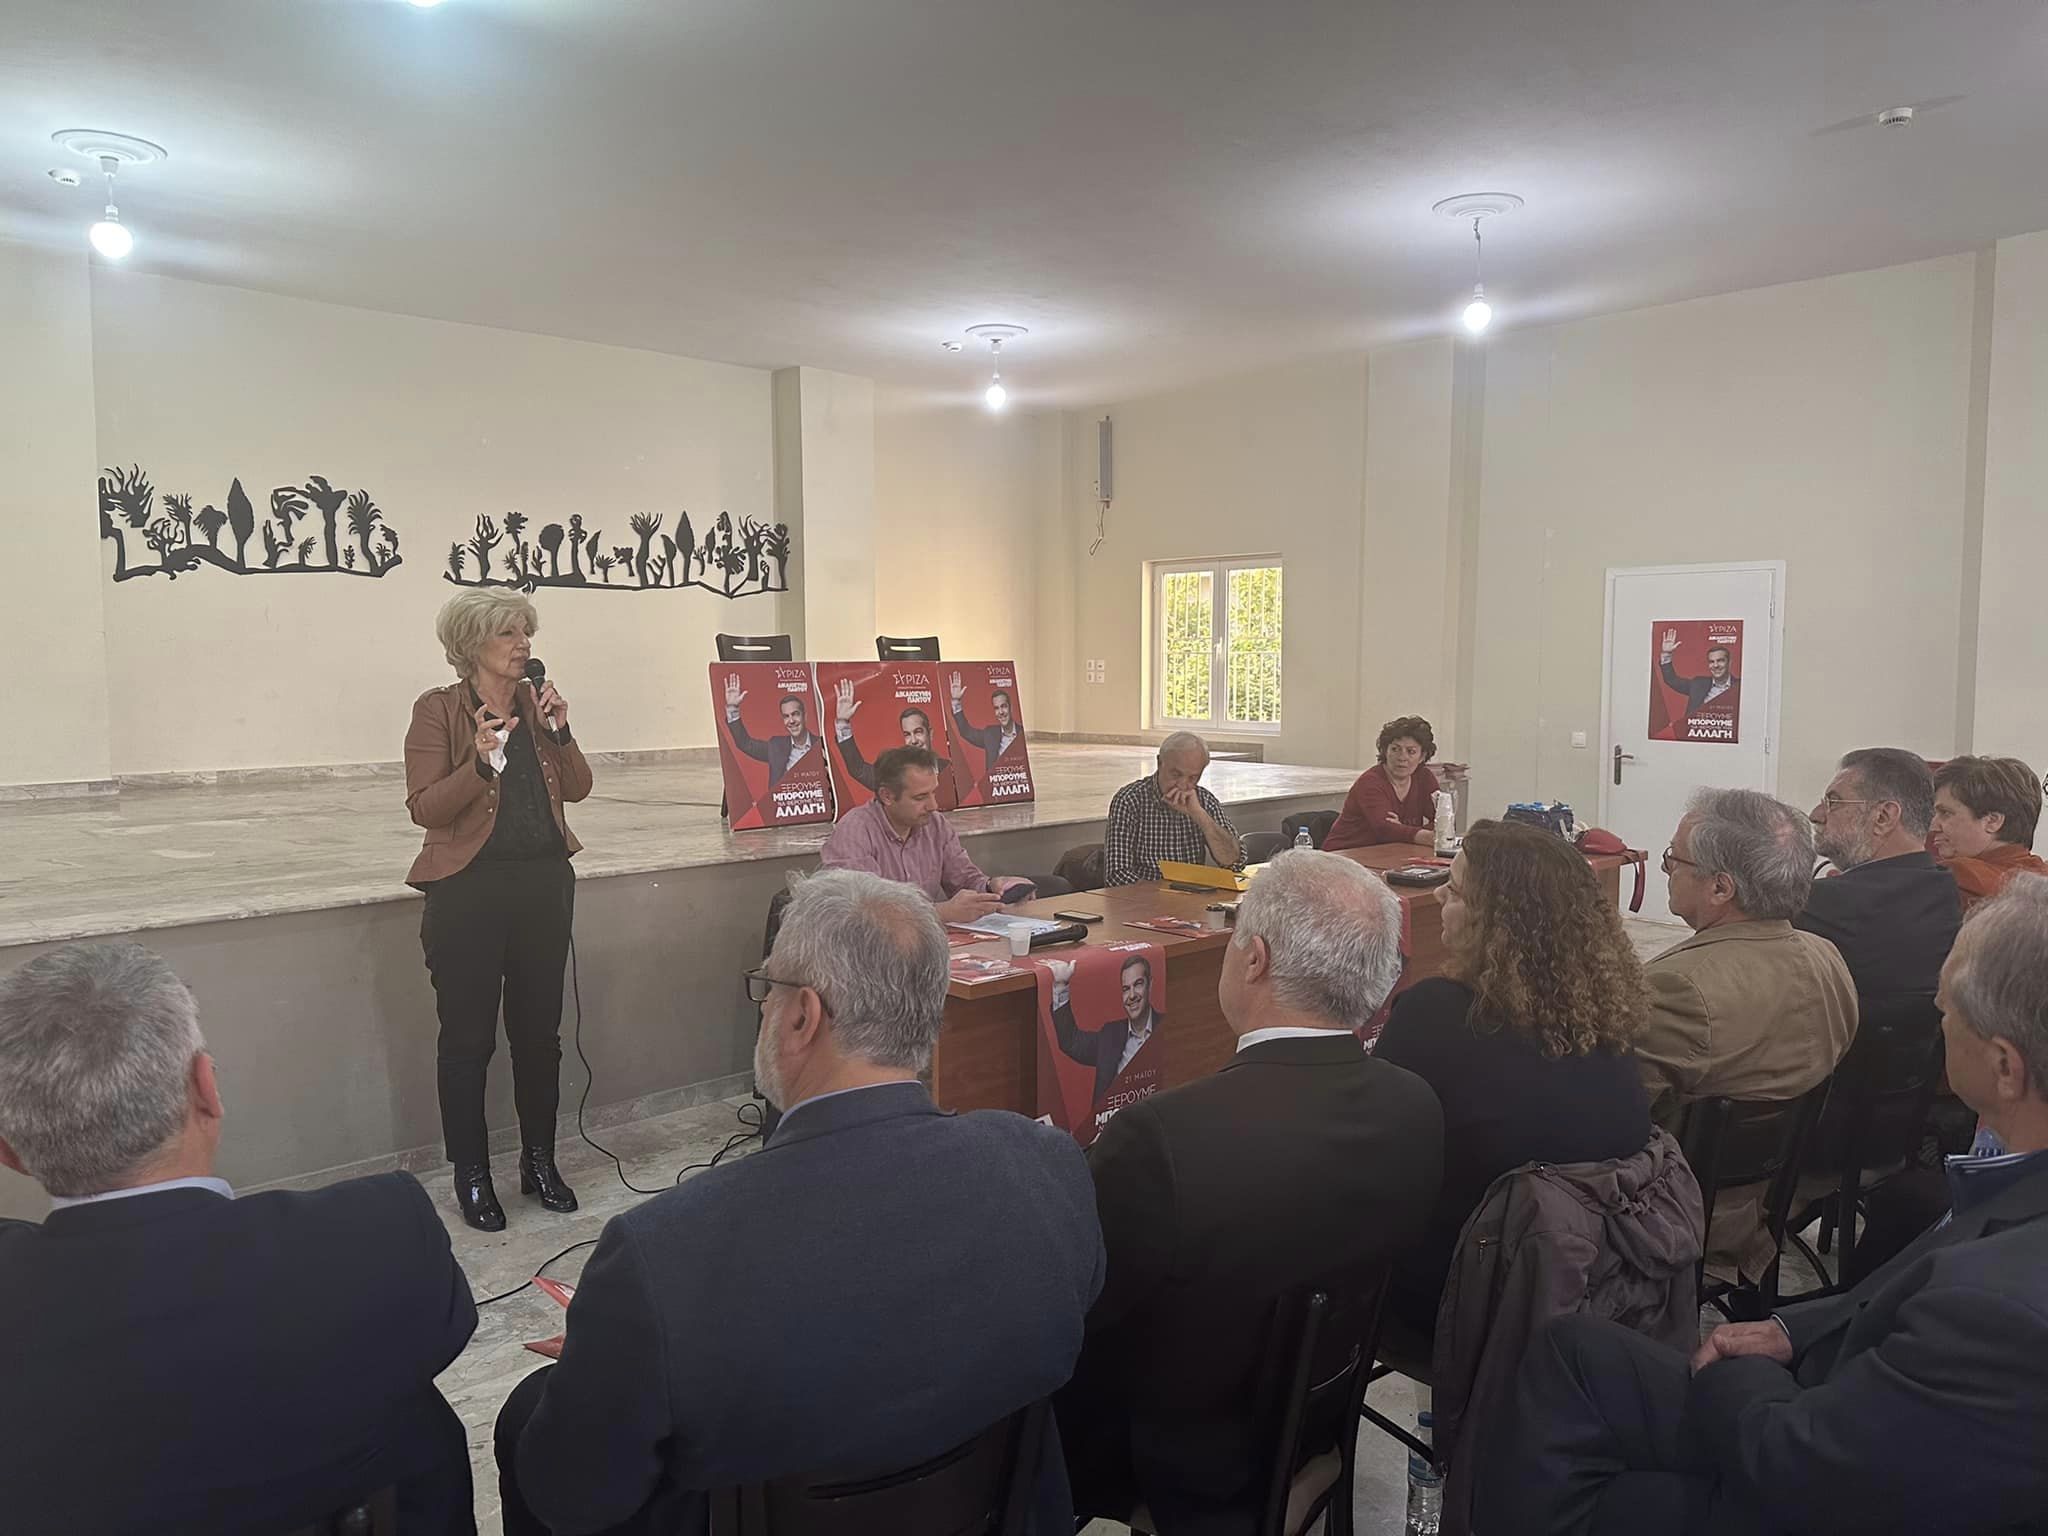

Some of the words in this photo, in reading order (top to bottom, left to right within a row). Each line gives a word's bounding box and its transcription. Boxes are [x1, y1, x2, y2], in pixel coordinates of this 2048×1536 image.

[892, 669, 930, 685] ΣΥΡΙΖΑ
[1687, 728, 1733, 739] ΑΛΛΑΓΗ
[773, 789, 823, 802] ΜΠΟΡΟΥΜΕ
[992, 783, 1030, 797] ΑΛΛΑΓΗ
[775, 802, 826, 818] ΑΛΛΑΓΗ
